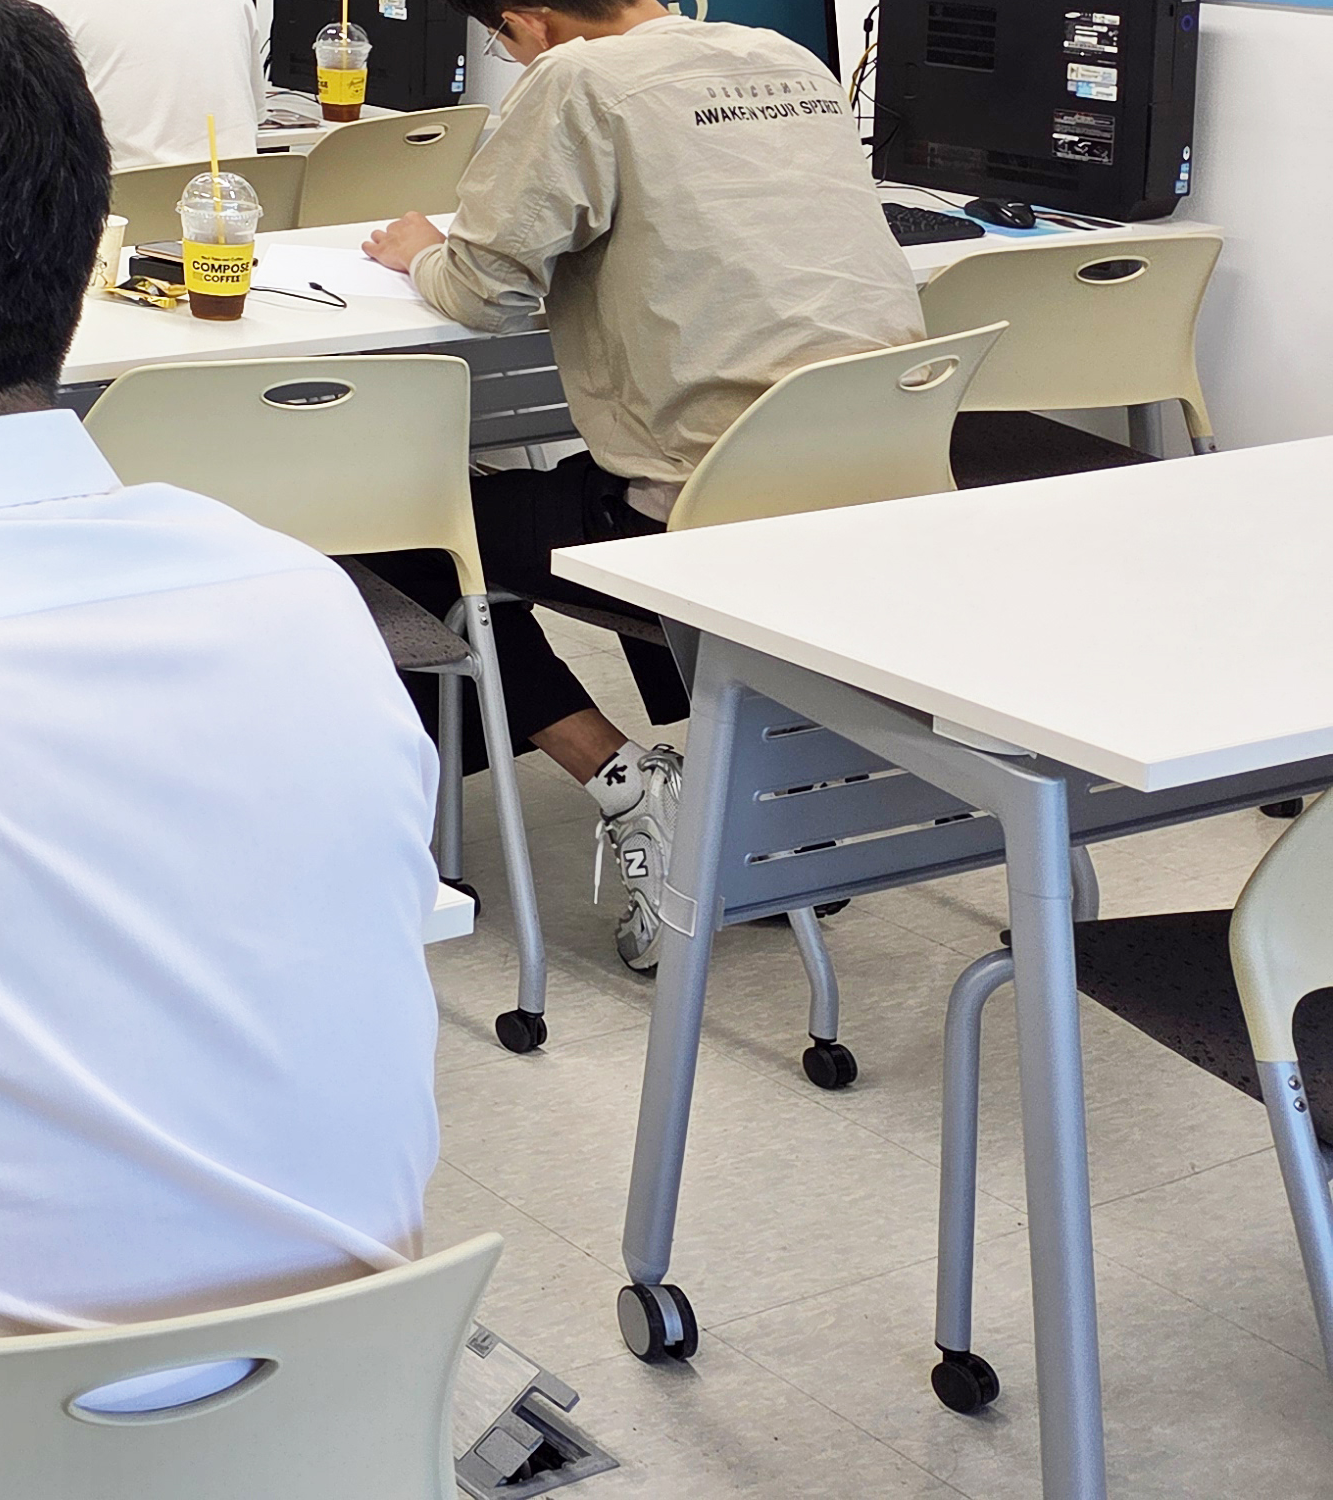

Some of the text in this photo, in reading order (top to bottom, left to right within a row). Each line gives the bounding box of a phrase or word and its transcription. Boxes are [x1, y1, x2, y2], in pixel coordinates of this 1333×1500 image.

[694, 104, 759, 126] AWAKEN
[755, 103, 800, 121] YOUR
[192, 260, 250, 274] COMPOSE
[203, 274, 241, 283] COFFEE
